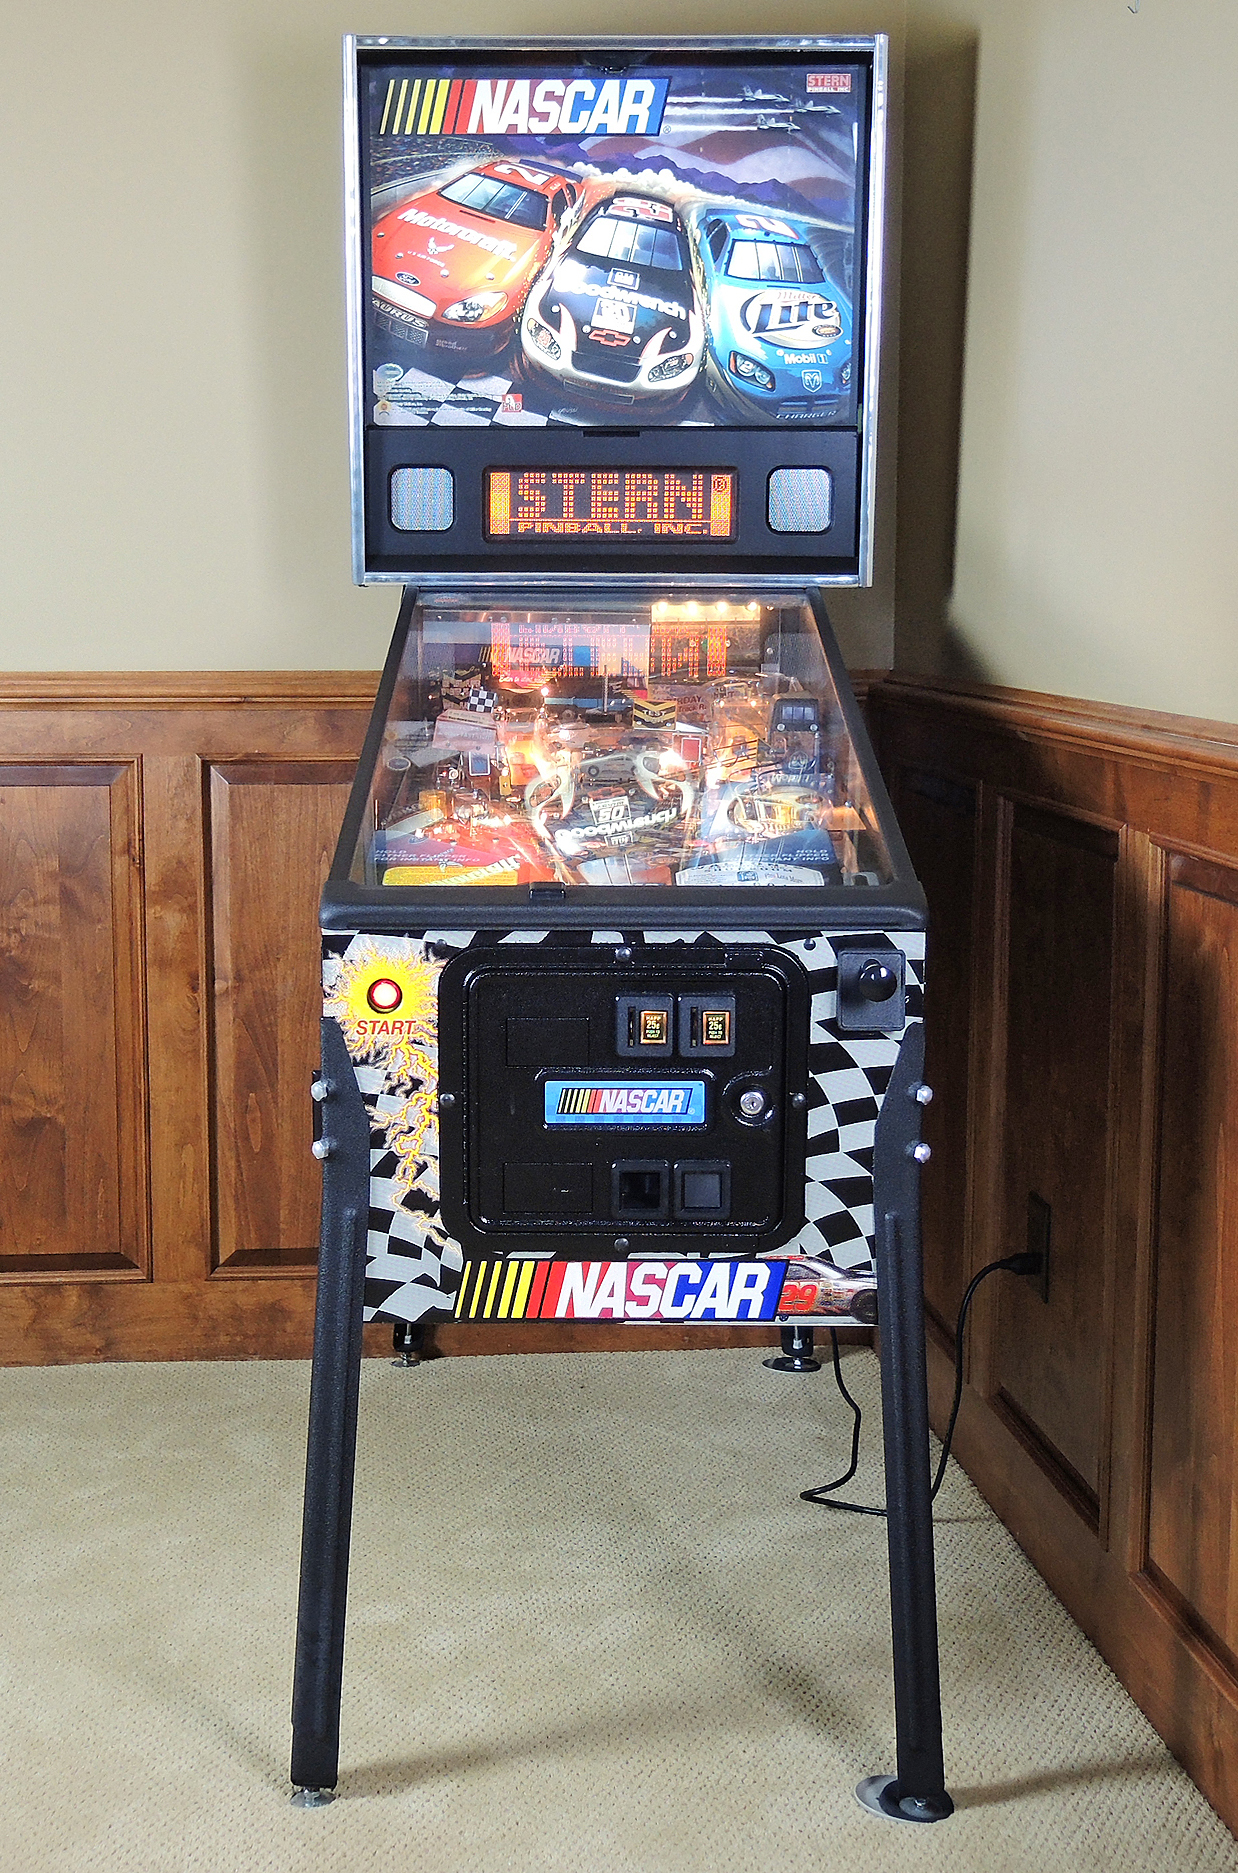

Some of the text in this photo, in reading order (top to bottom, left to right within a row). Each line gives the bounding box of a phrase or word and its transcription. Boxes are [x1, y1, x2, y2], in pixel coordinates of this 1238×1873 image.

[808, 75, 850, 87] STERN
[467, 78, 655, 134] NASCAR
[396, 208, 518, 263] Motorcraft
[552, 272, 687, 322] oodwrench
[751, 300, 838, 334] Lite
[783, 352, 817, 365] Mobil
[518, 472, 704, 519] STERN
[356, 1020, 416, 1035] START
[598, 1089, 685, 1113] NASCAR
[554, 1261, 771, 1318] NASCAR
[779, 1284, 818, 1311] 29
